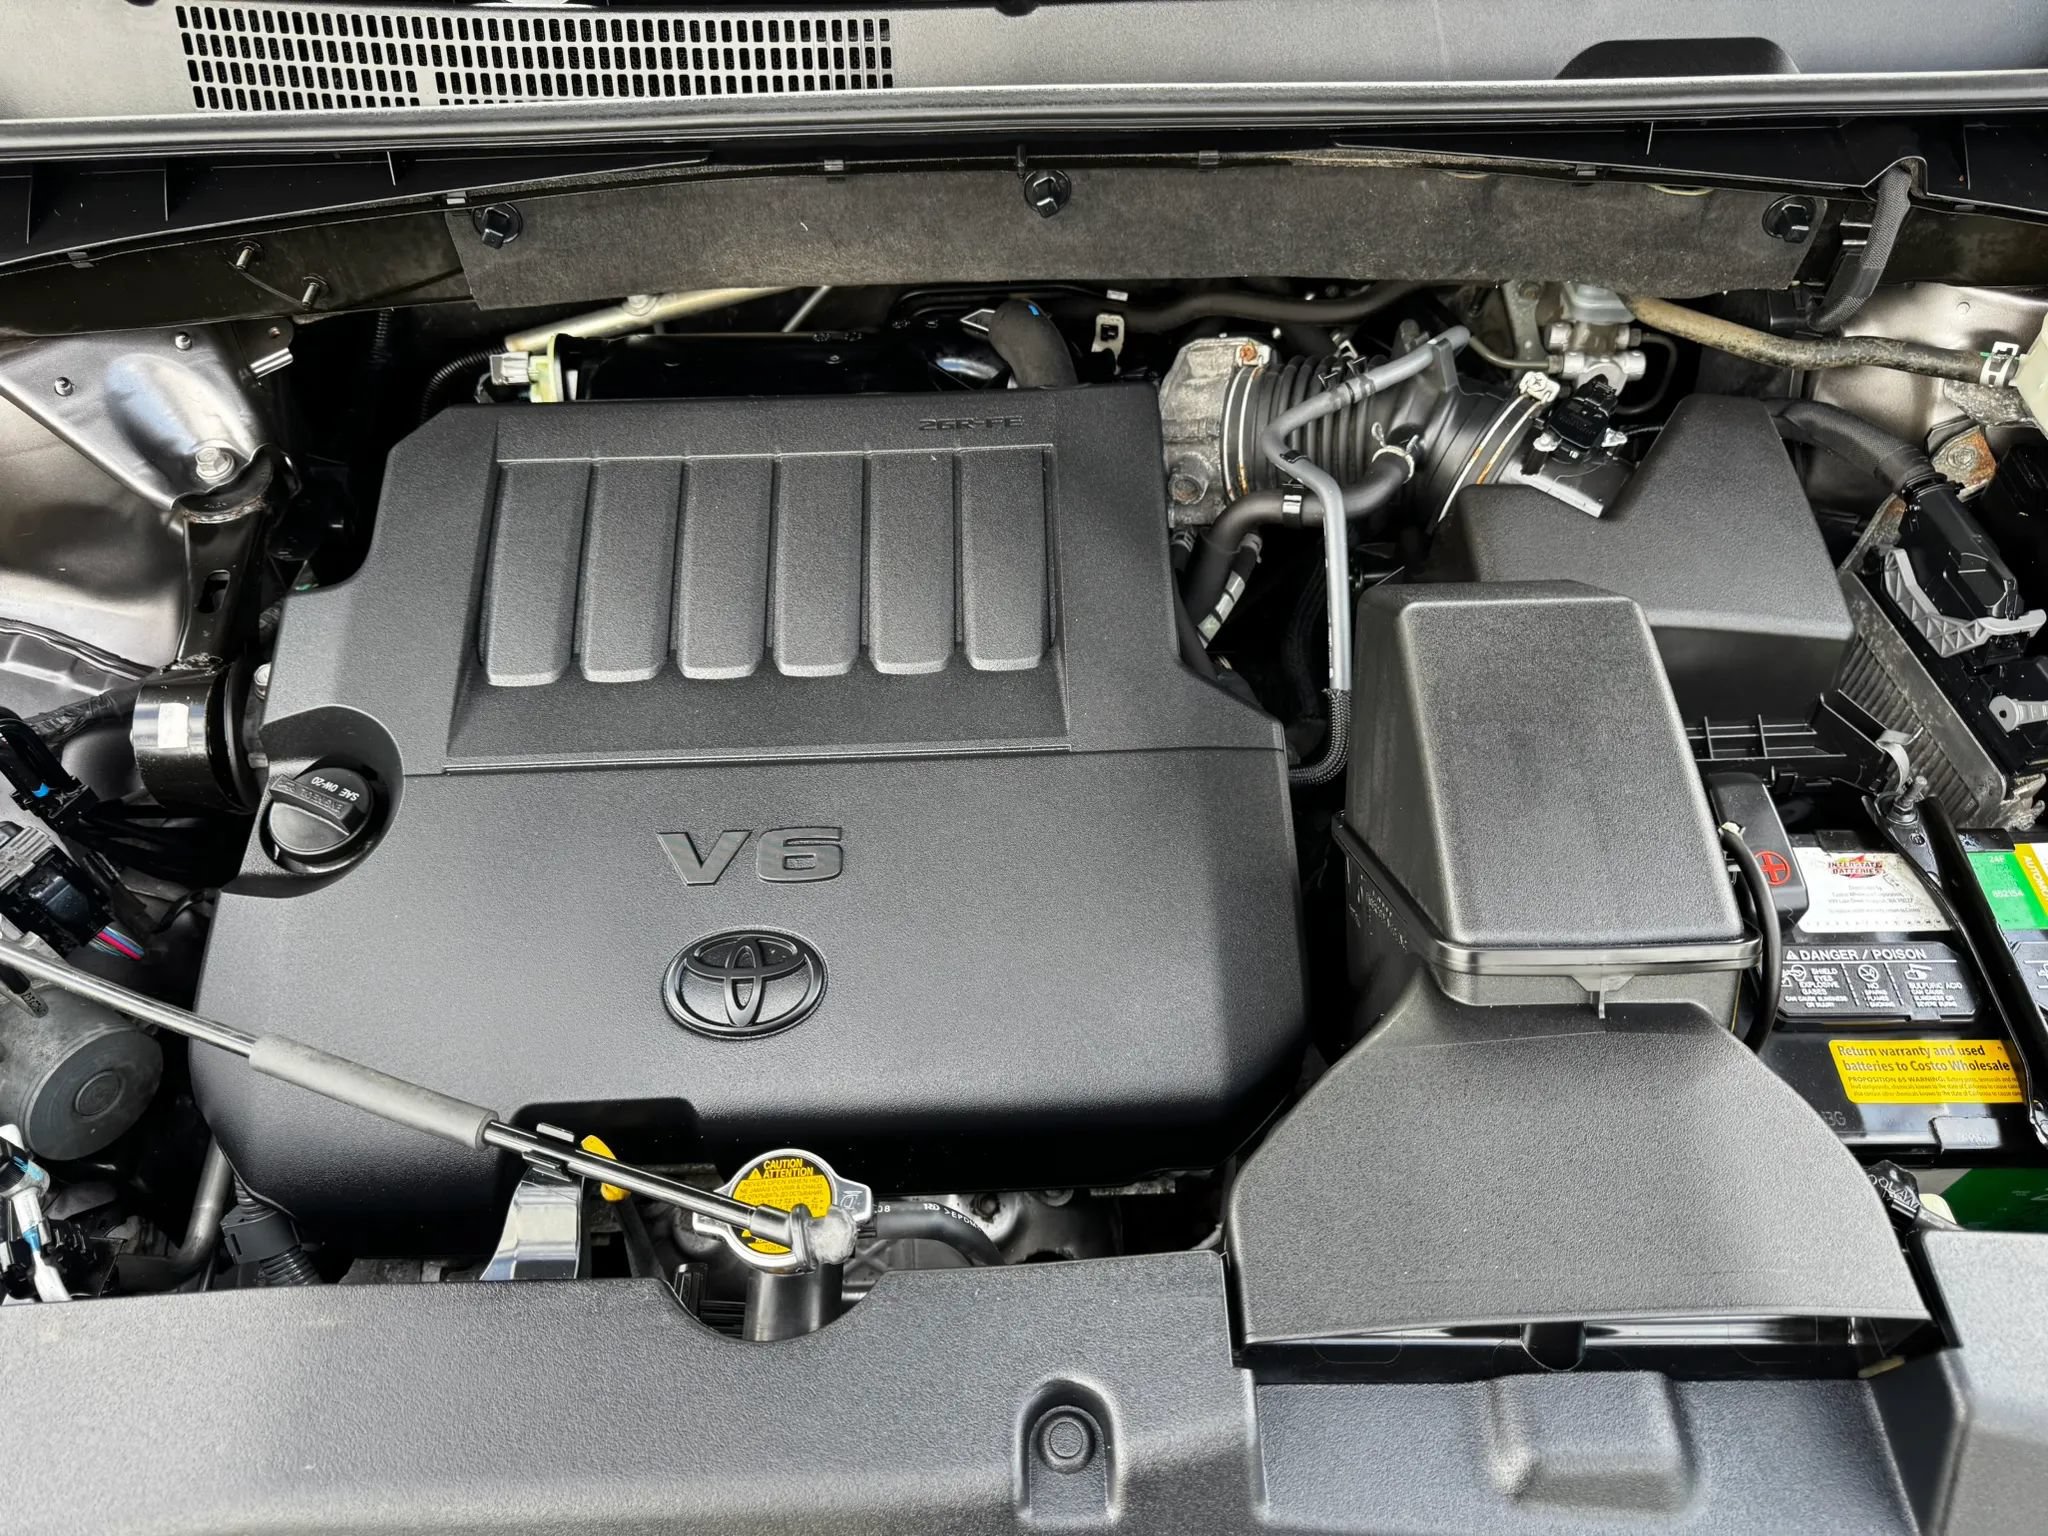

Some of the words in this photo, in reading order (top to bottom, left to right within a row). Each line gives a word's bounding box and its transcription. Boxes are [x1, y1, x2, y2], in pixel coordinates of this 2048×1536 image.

[918, 415, 1024, 431] 2GR-FE
[311, 776, 338, 793] 0W-20
[338, 788, 360, 801] SAE
[656, 826, 844, 886] V6
[1828, 861, 1882, 869] INTERSTATE
[2023, 856, 2048, 903] AUTOMO
[1799, 949, 1859, 960] DANGER
[1861, 949, 1868, 960] /
[1871, 948, 1927, 960] POISON
[1837, 1045, 1878, 1057] Return
[1879, 1046, 1931, 1059] warranty
[1933, 1044, 1956, 1056] and
[1957, 1044, 1986, 1056] used
[1842, 1059, 1895, 1072] batteries
[1896, 1061, 1909, 1072] to
[1910, 1060, 1948, 1072] Costco
[1948, 1059, 2011, 1072] Wholesale
[763, 1158, 803, 1170] CAUTION
[763, 1167, 814, 1178] ATTENTION
